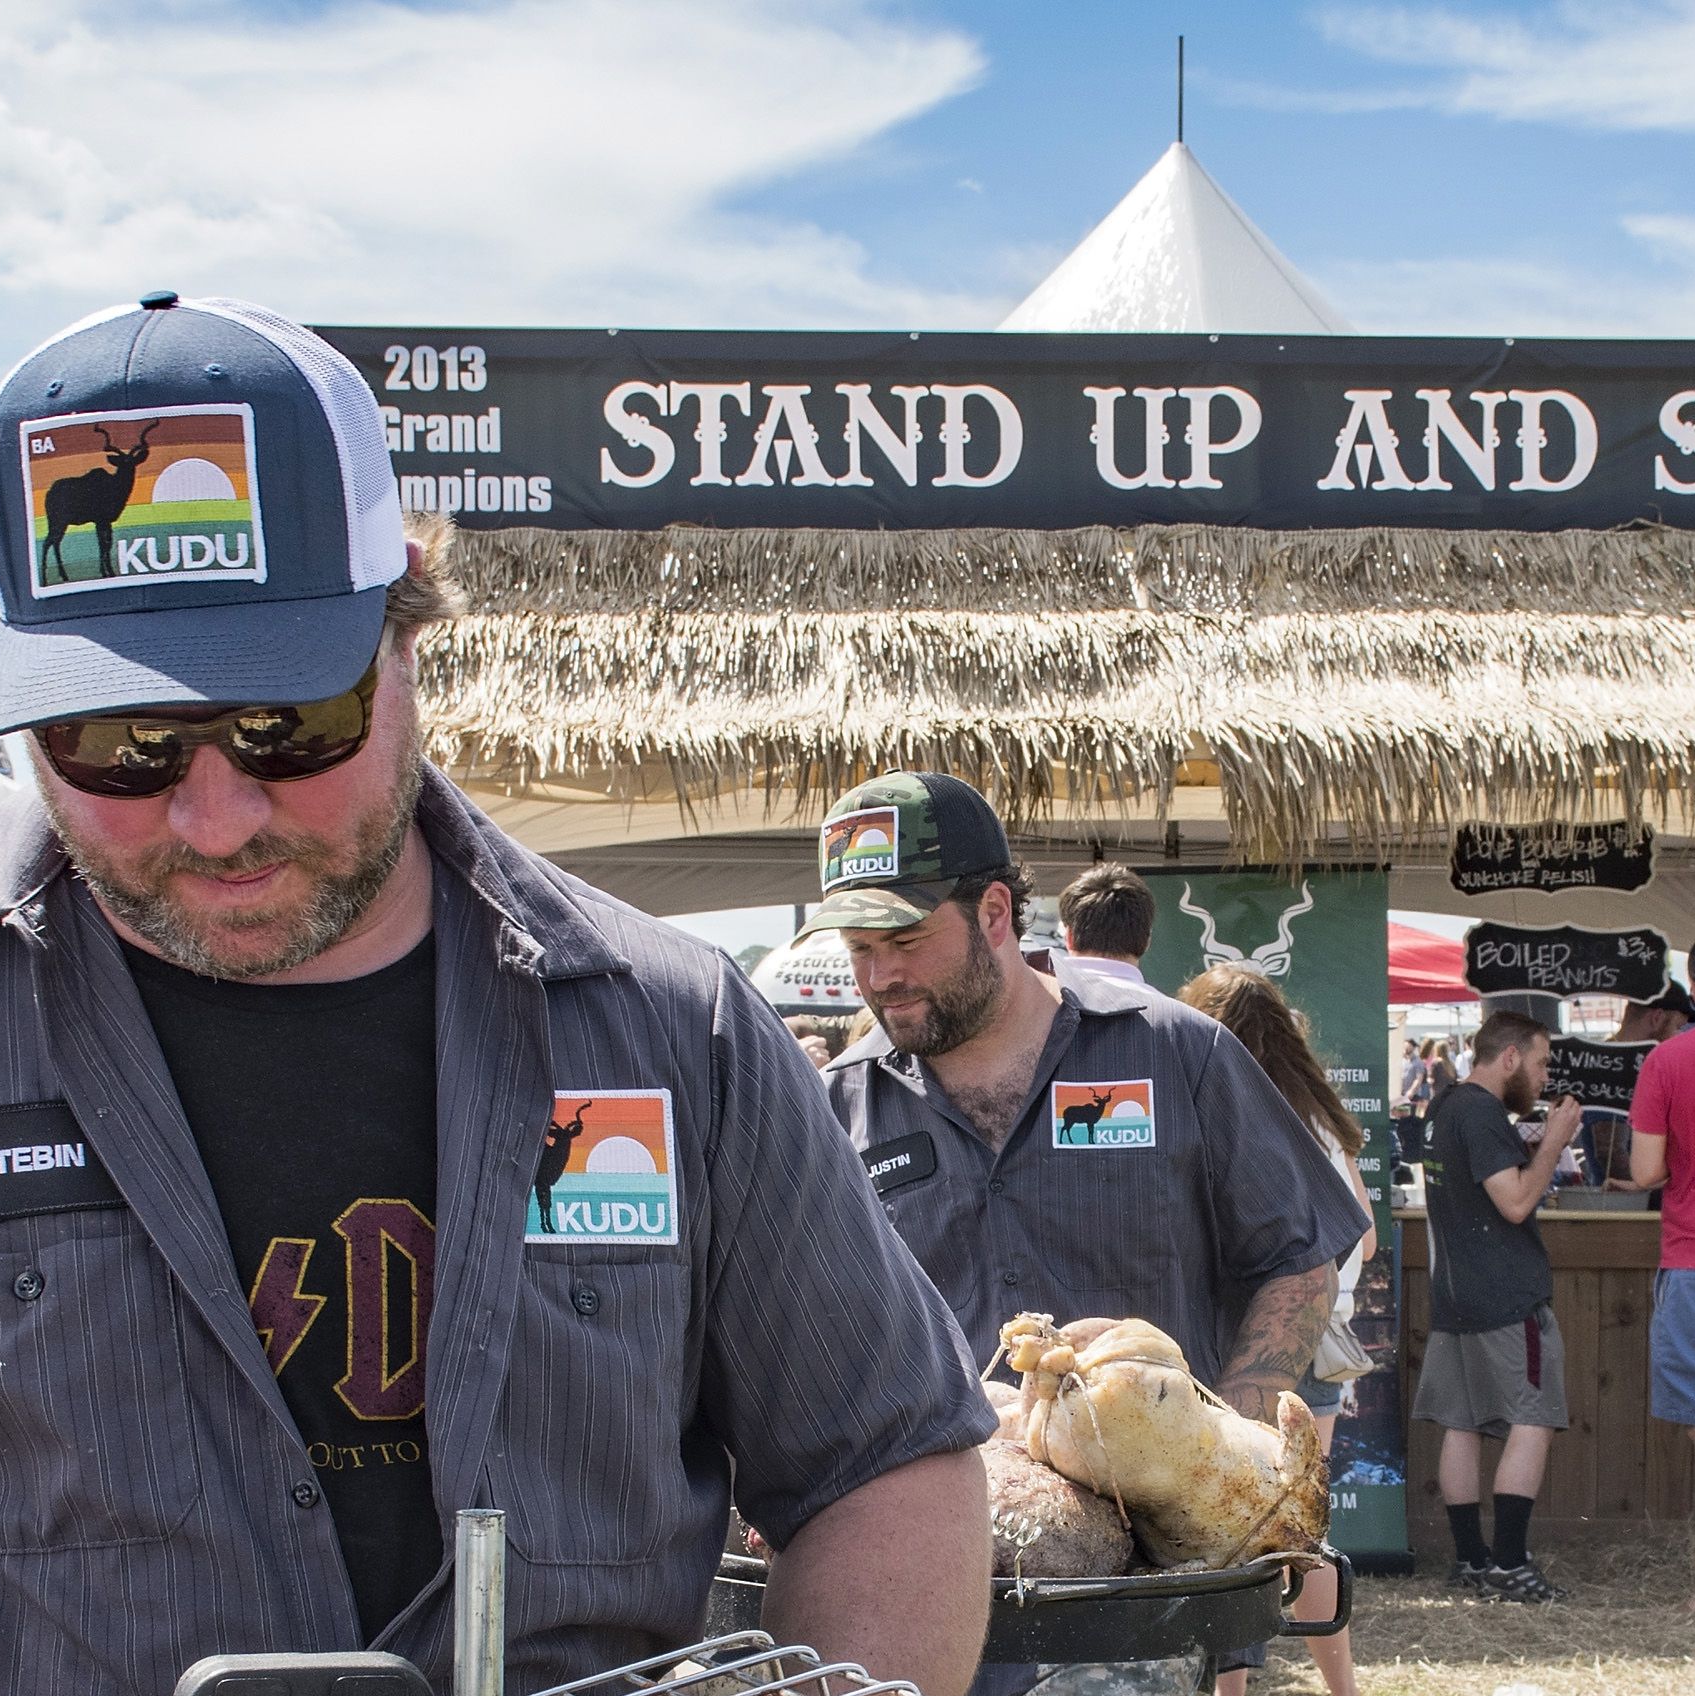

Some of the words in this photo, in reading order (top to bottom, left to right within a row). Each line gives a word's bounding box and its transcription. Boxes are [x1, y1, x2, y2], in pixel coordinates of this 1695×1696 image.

[384, 344, 488, 391] 2013
[380, 405, 502, 453] Grand
[601, 380, 1023, 488] STAND
[1083, 384, 1263, 490] UP
[1316, 388, 1599, 492] AND
[31, 436, 56, 454] BA
[400, 468, 552, 513] mpions
[117, 531, 249, 576] KUDU
[842, 856, 892, 875] KUDU
[1476, 940, 1571, 970] BOILED
[1527, 965, 1621, 990] PEANUTS
[1568, 1048, 1625, 1072] WINGS
[1325, 1068, 1369, 1083] SYSTEM
[1096, 1128, 1150, 1144] KUDU
[868, 1152, 911, 1179] JUSTIN
[556, 1201, 666, 1234] KUDU
[372, 1439, 420, 1466] TO
